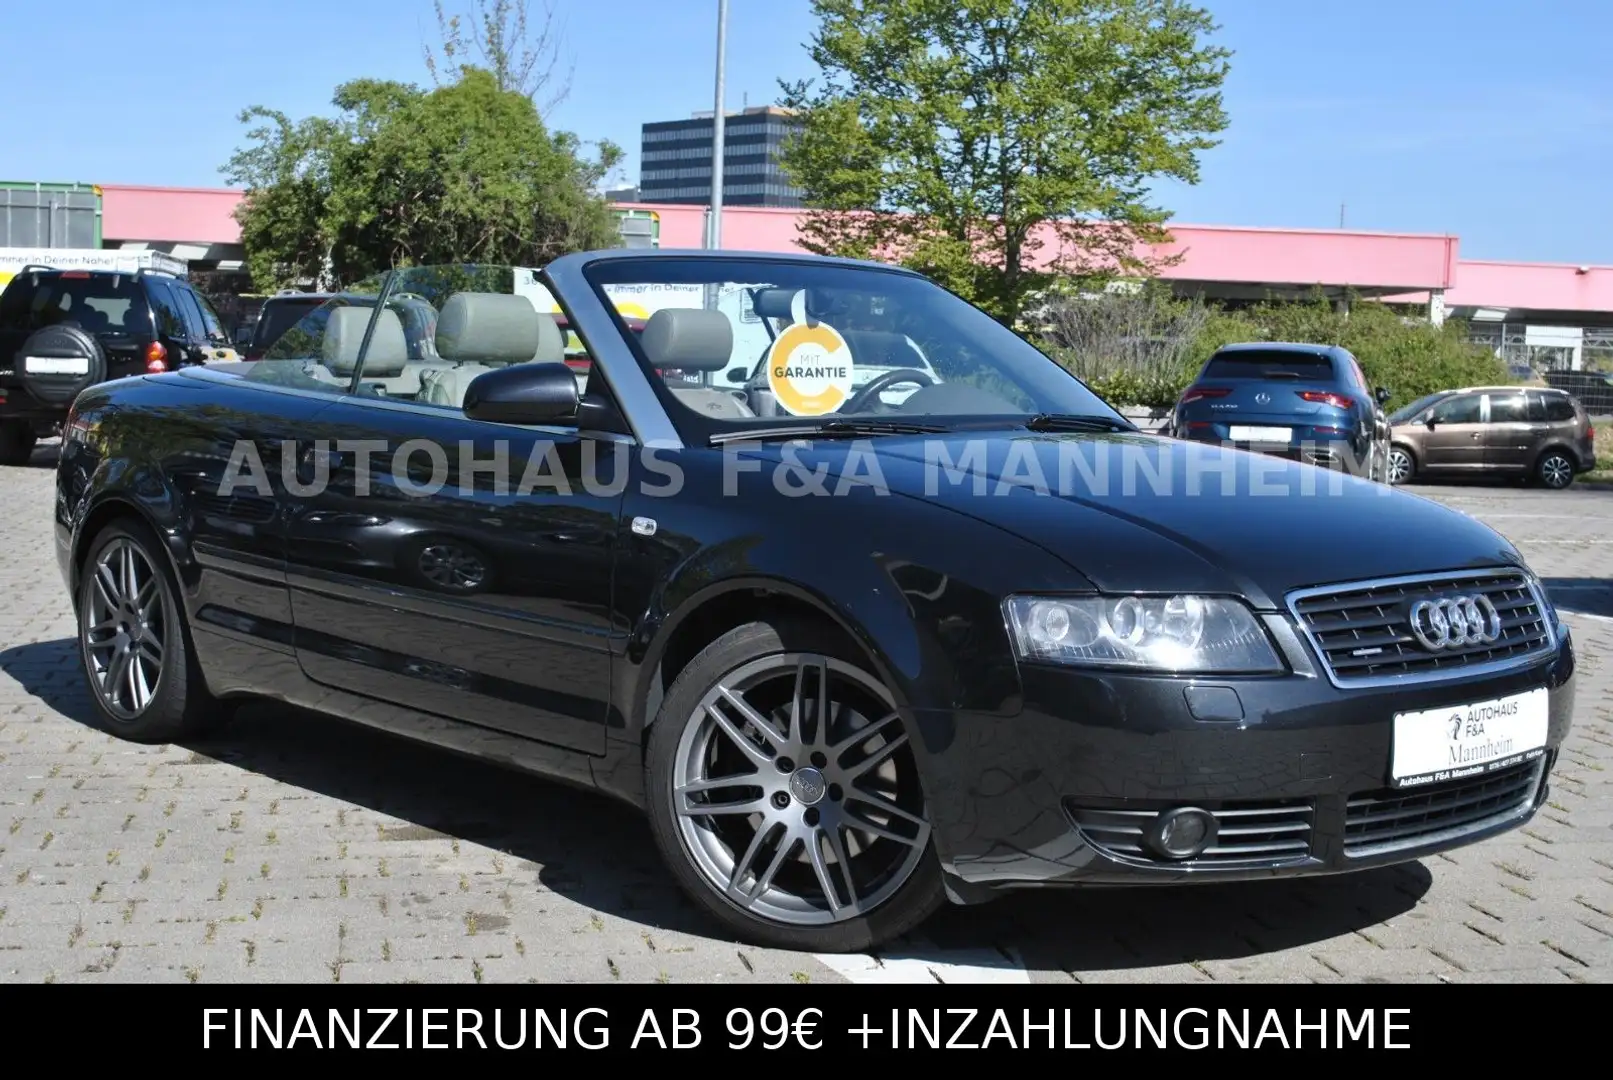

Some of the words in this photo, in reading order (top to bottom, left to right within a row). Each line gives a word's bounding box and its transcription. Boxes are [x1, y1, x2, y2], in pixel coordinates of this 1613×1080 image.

[800, 354, 820, 366] MIT
[774, 366, 847, 378] GARANTIE
[1466, 702, 1518, 722] AUTOHAUS
[1466, 724, 1485, 738] F&A
[1449, 736, 1514, 765] Mannheim
[1399, 775, 1433, 787] Autohaus
[1435, 772, 1450, 782] F&A
